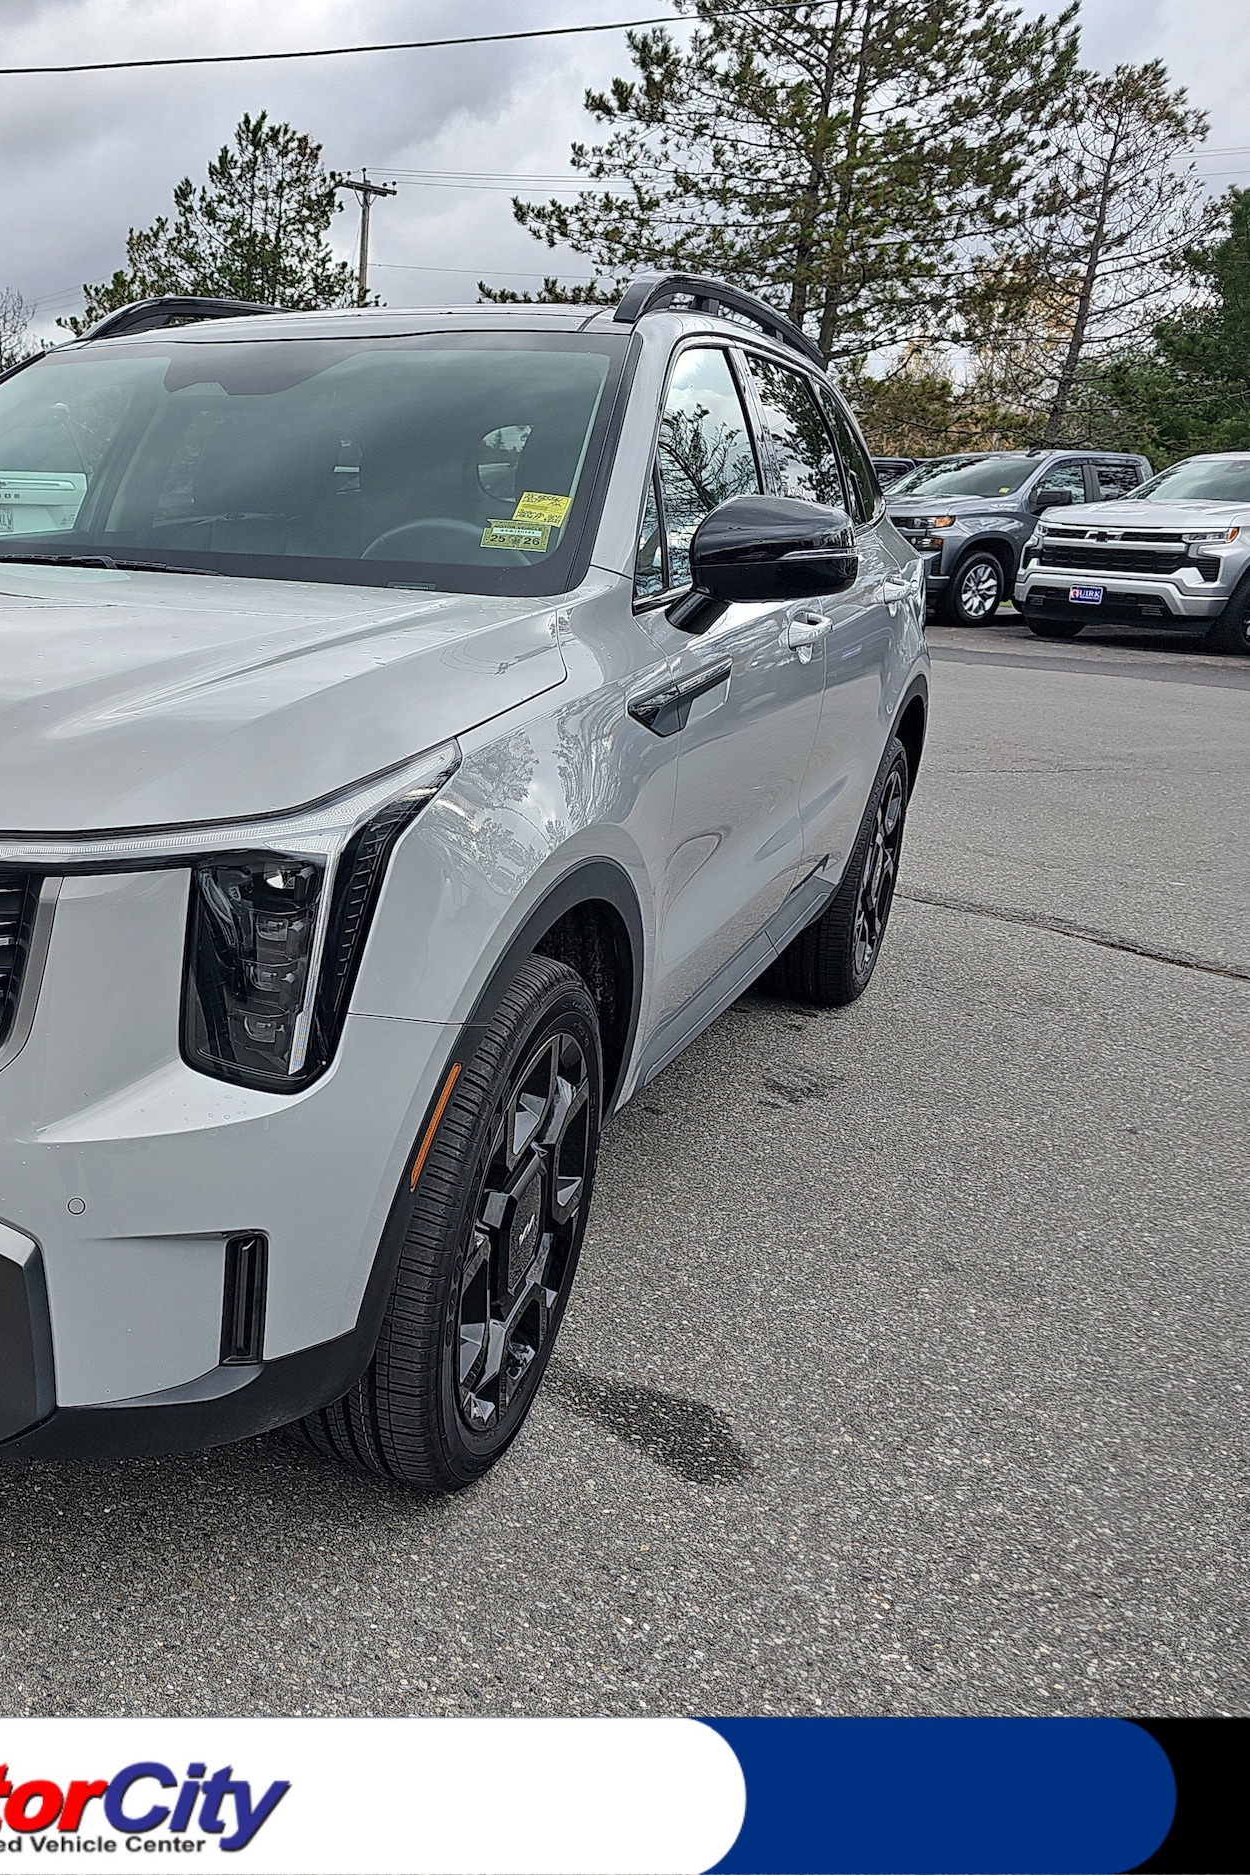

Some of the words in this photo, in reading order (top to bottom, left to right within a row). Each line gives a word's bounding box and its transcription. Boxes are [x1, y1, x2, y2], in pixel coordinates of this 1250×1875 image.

[490, 534, 506, 543] 25
[523, 537, 540, 546] 26
[1071, 588, 1101, 599] QUIRK
